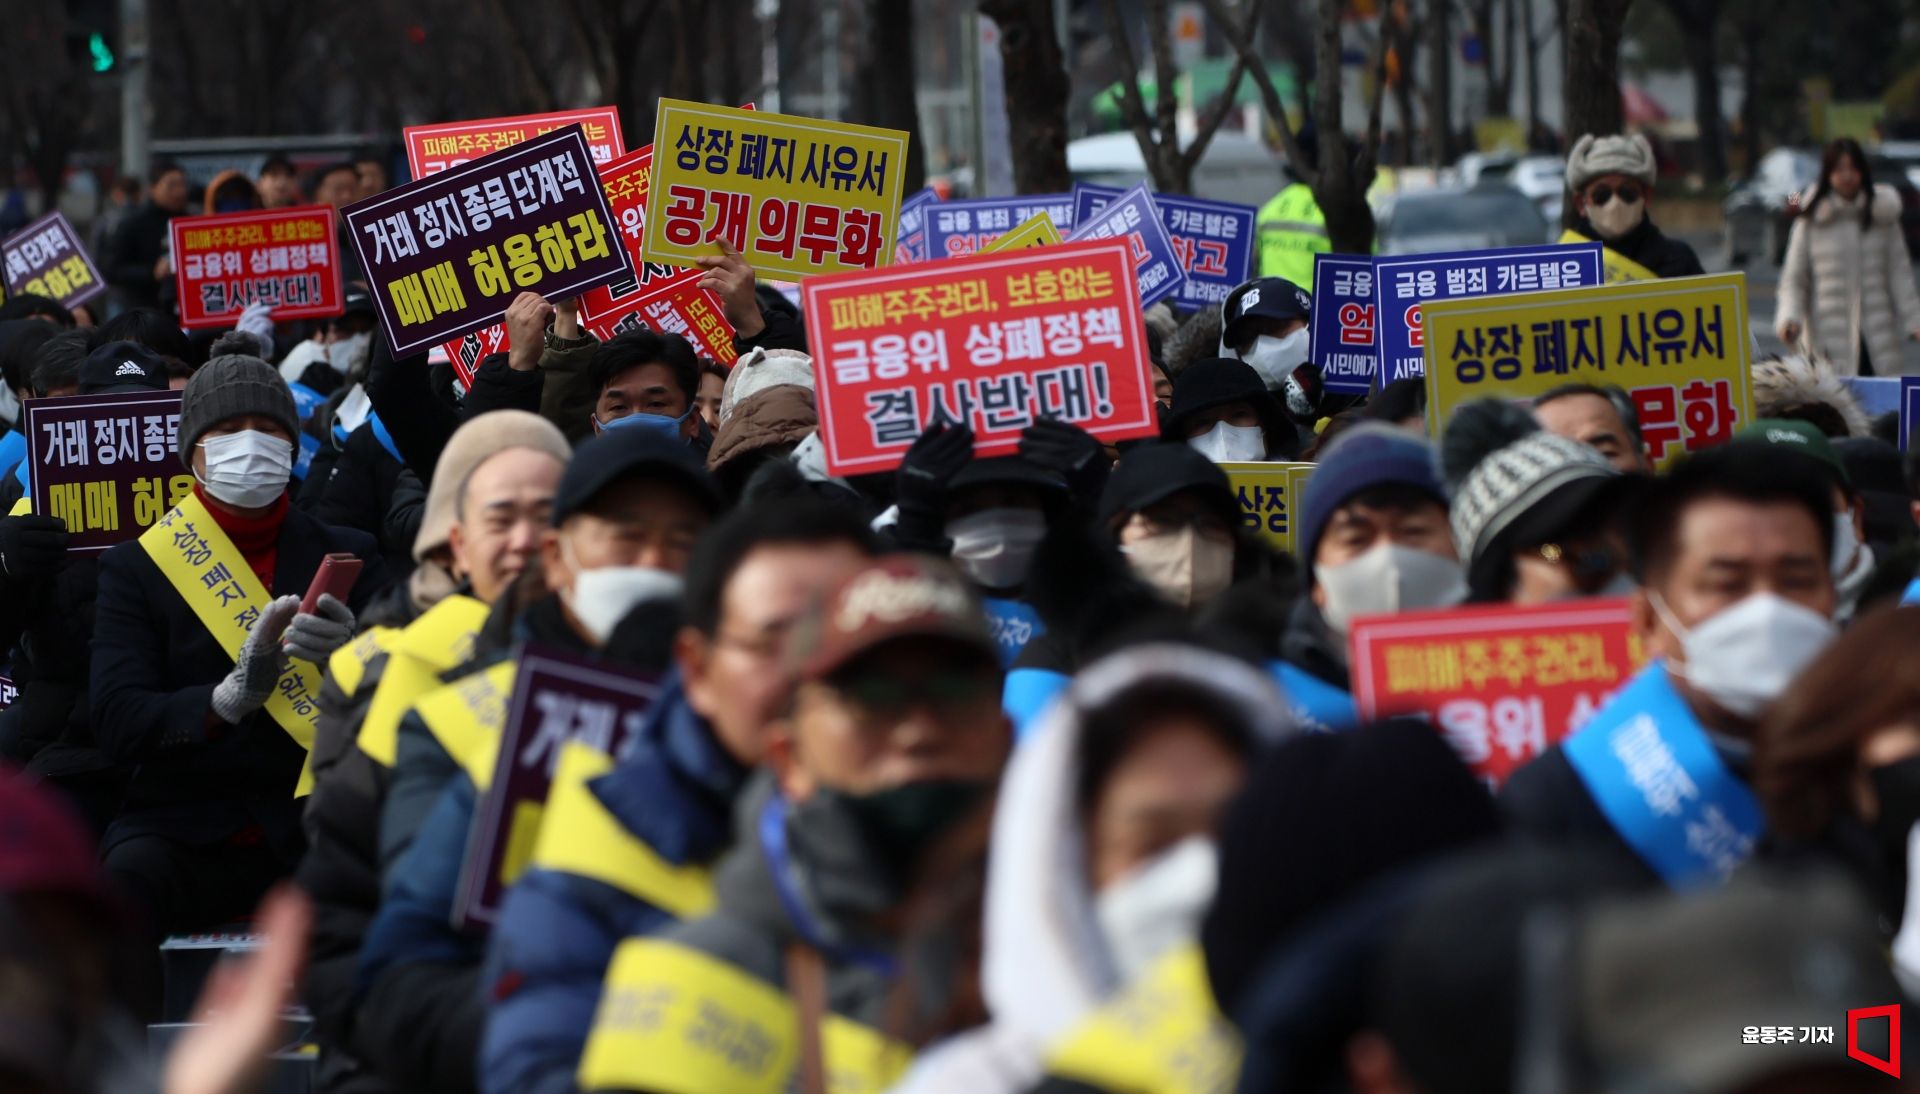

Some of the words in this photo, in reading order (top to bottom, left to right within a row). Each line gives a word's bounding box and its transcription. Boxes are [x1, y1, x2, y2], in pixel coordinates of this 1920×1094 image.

[675, 124, 734, 175] 상장
[736, 133, 797, 184] 폐지
[800, 142, 888, 197] 사유서
[363, 211, 421, 266] 거래
[413, 193, 469, 249] 정지
[460, 170, 516, 233] 종목
[506, 150, 587, 216] 단계적
[663, 184, 752, 254] 공개
[754, 197, 885, 271] 의무화
[185, 250, 243, 280] 금융위
[249, 242, 330, 275] 상폐정책
[200, 271, 323, 317] 결사반대!
[387, 260, 468, 328] 매매
[467, 208, 611, 297] 허용하라
[1333, 270, 1373, 297] 금융
[1396, 270, 1437, 298] 금융
[1446, 267, 1487, 294] 범죄
[1497, 260, 1582, 291] 카르텔은
[829, 280, 999, 331] 피해주주권리,
[1006, 265, 1114, 308] 보호없는
[115, 368, 146, 377] adidas
[832, 327, 949, 386] 금융위
[964, 306, 1125, 367] 상폐정책
[1450, 323, 1523, 384] 상장
[1530, 316, 1606, 375] 폐지
[1615, 304, 1725, 367] 사유서
[864, 360, 1115, 449] 결사반대!
[1630, 379, 1738, 463] 무화
[43, 419, 89, 468] 거래
[94, 416, 140, 465] 정지
[50, 480, 119, 534] 매매
[172, 522, 213, 567] 상장
[200, 561, 247, 608] 폐지
[233, 604, 262, 633] 정
[1437, 695, 1548, 764] 융위
